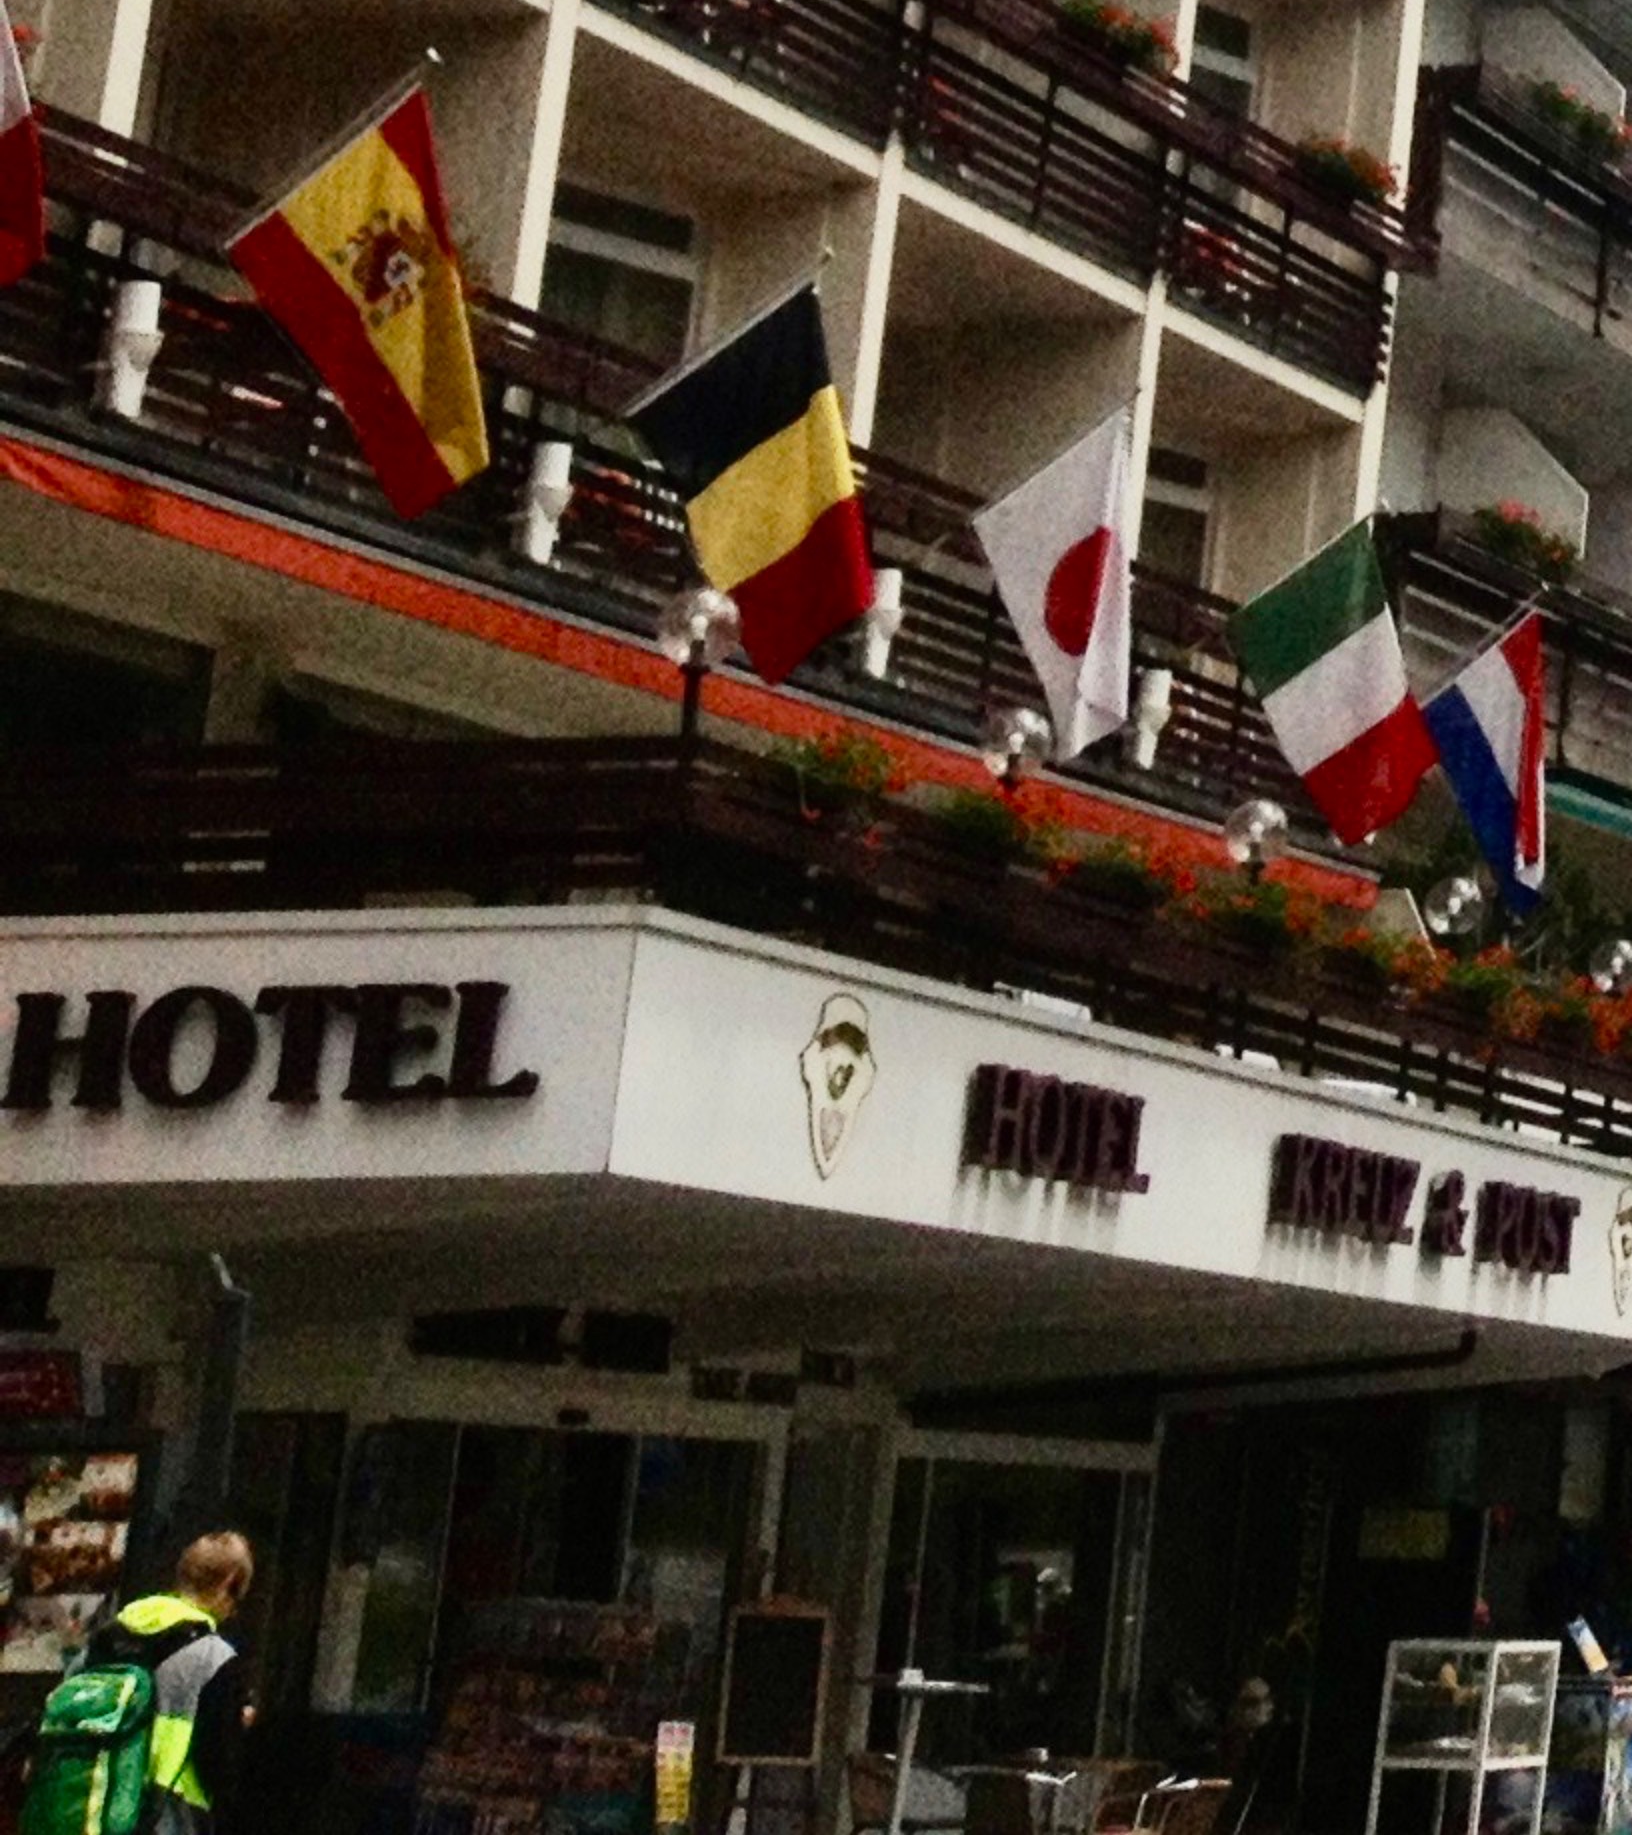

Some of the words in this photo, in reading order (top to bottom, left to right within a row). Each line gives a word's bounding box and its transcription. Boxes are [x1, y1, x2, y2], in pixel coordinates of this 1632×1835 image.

[0, 980, 541, 1109] HOTEL
[957, 1062, 1151, 1194] HOTEL
[1264, 1132, 1422, 1246] KREUZ
[1420, 1168, 1470, 1257] &
[1473, 1180, 1582, 1276] POST
